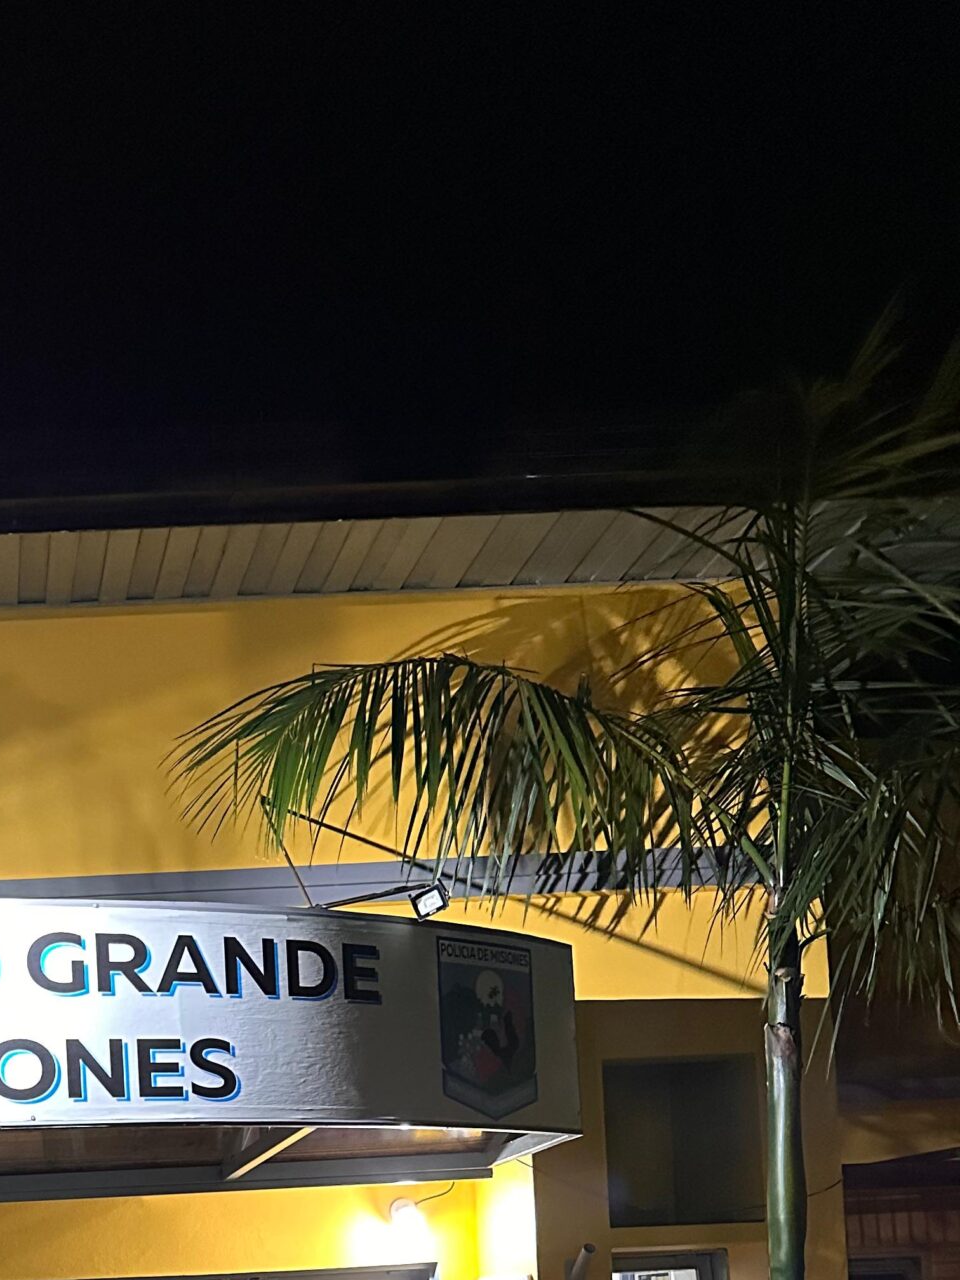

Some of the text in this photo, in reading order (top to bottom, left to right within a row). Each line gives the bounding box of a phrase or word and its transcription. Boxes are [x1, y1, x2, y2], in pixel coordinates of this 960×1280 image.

[26, 932, 382, 1005] GRANDE
[476, 948, 489, 962] DE
[489, 951, 529, 967] MISIONES
